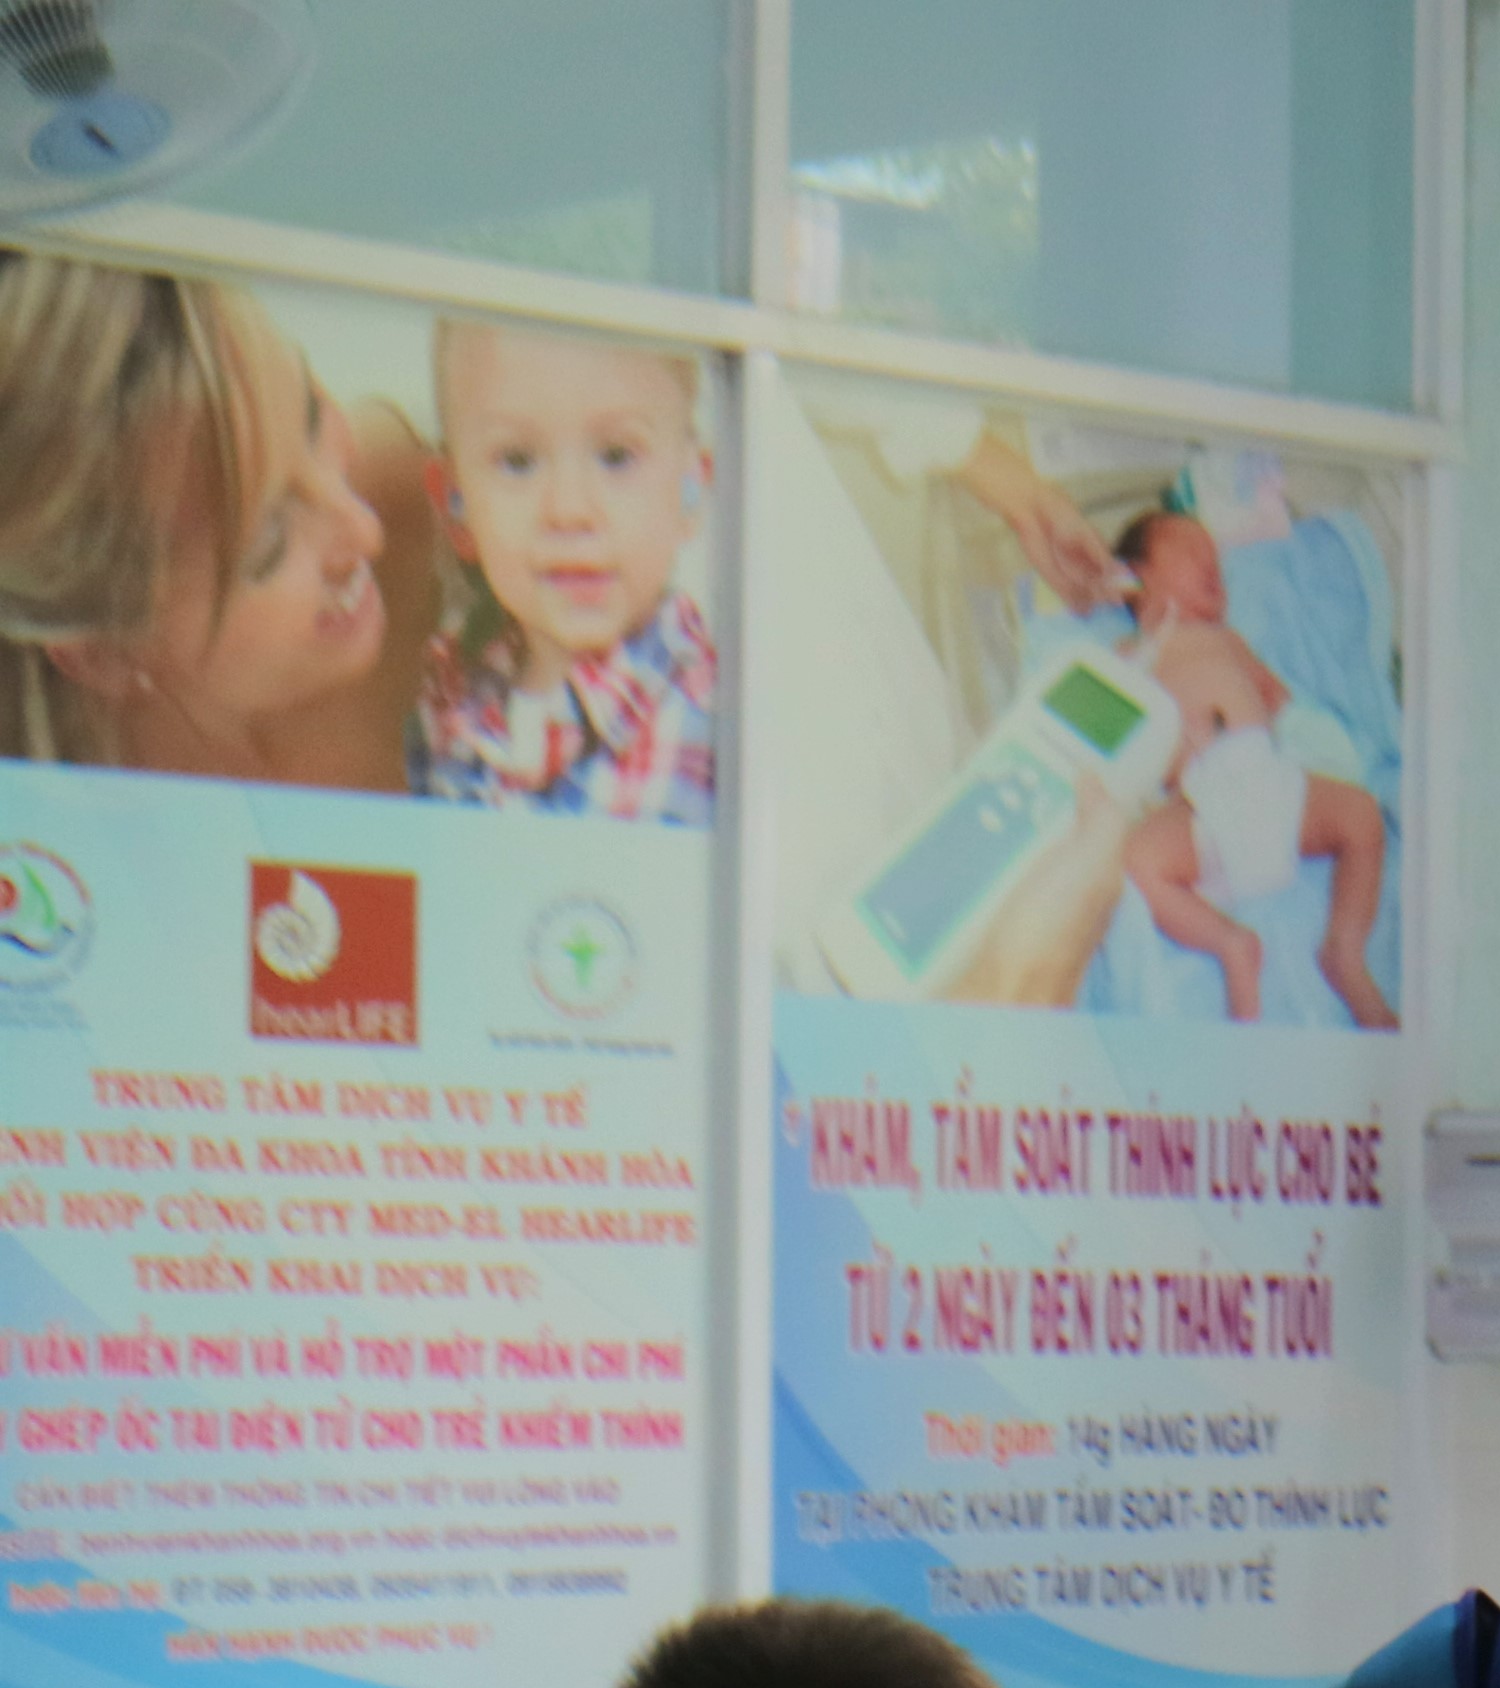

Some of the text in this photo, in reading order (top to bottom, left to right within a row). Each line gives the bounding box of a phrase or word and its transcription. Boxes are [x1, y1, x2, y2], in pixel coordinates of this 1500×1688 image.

[91, 1068, 588, 1130] TRUNG TÂM DỊCH VỤ Y TẾ
[79, 1127, 177, 1175] VIỆN
[257, 1137, 367, 1180] KHOA
[378, 1136, 468, 1184] TỈNH
[478, 1141, 607, 1187] KHÁNH
[1014, 1084, 1093, 1196] SOÁT
[1104, 1090, 1197, 1197] THÍNH
[1276, 1116, 1334, 1206] CHO
[1345, 1099, 1384, 1207] BÉ
[156, 1189, 266, 1234] CÙNG
[277, 1199, 355, 1237] CTY
[519, 1206, 697, 1247] HEARLIFE
[130, 1240, 253, 1293] TRIỂN
[266, 1258, 362, 1298] KHAI
[374, 1260, 468, 1302] DỊCH
[903, 1266, 924, 1355] 2
[932, 1242, 1018, 1356] NGÀY
[1029, 1233, 1096, 1356] ĐẾN
[1153, 1249, 1256, 1358] THÁNG
[1263, 1229, 1333, 1359] TUỔI
[926, 1564, 1028, 1617] TRUNG
[1035, 1556, 1091, 1610] TÂM
